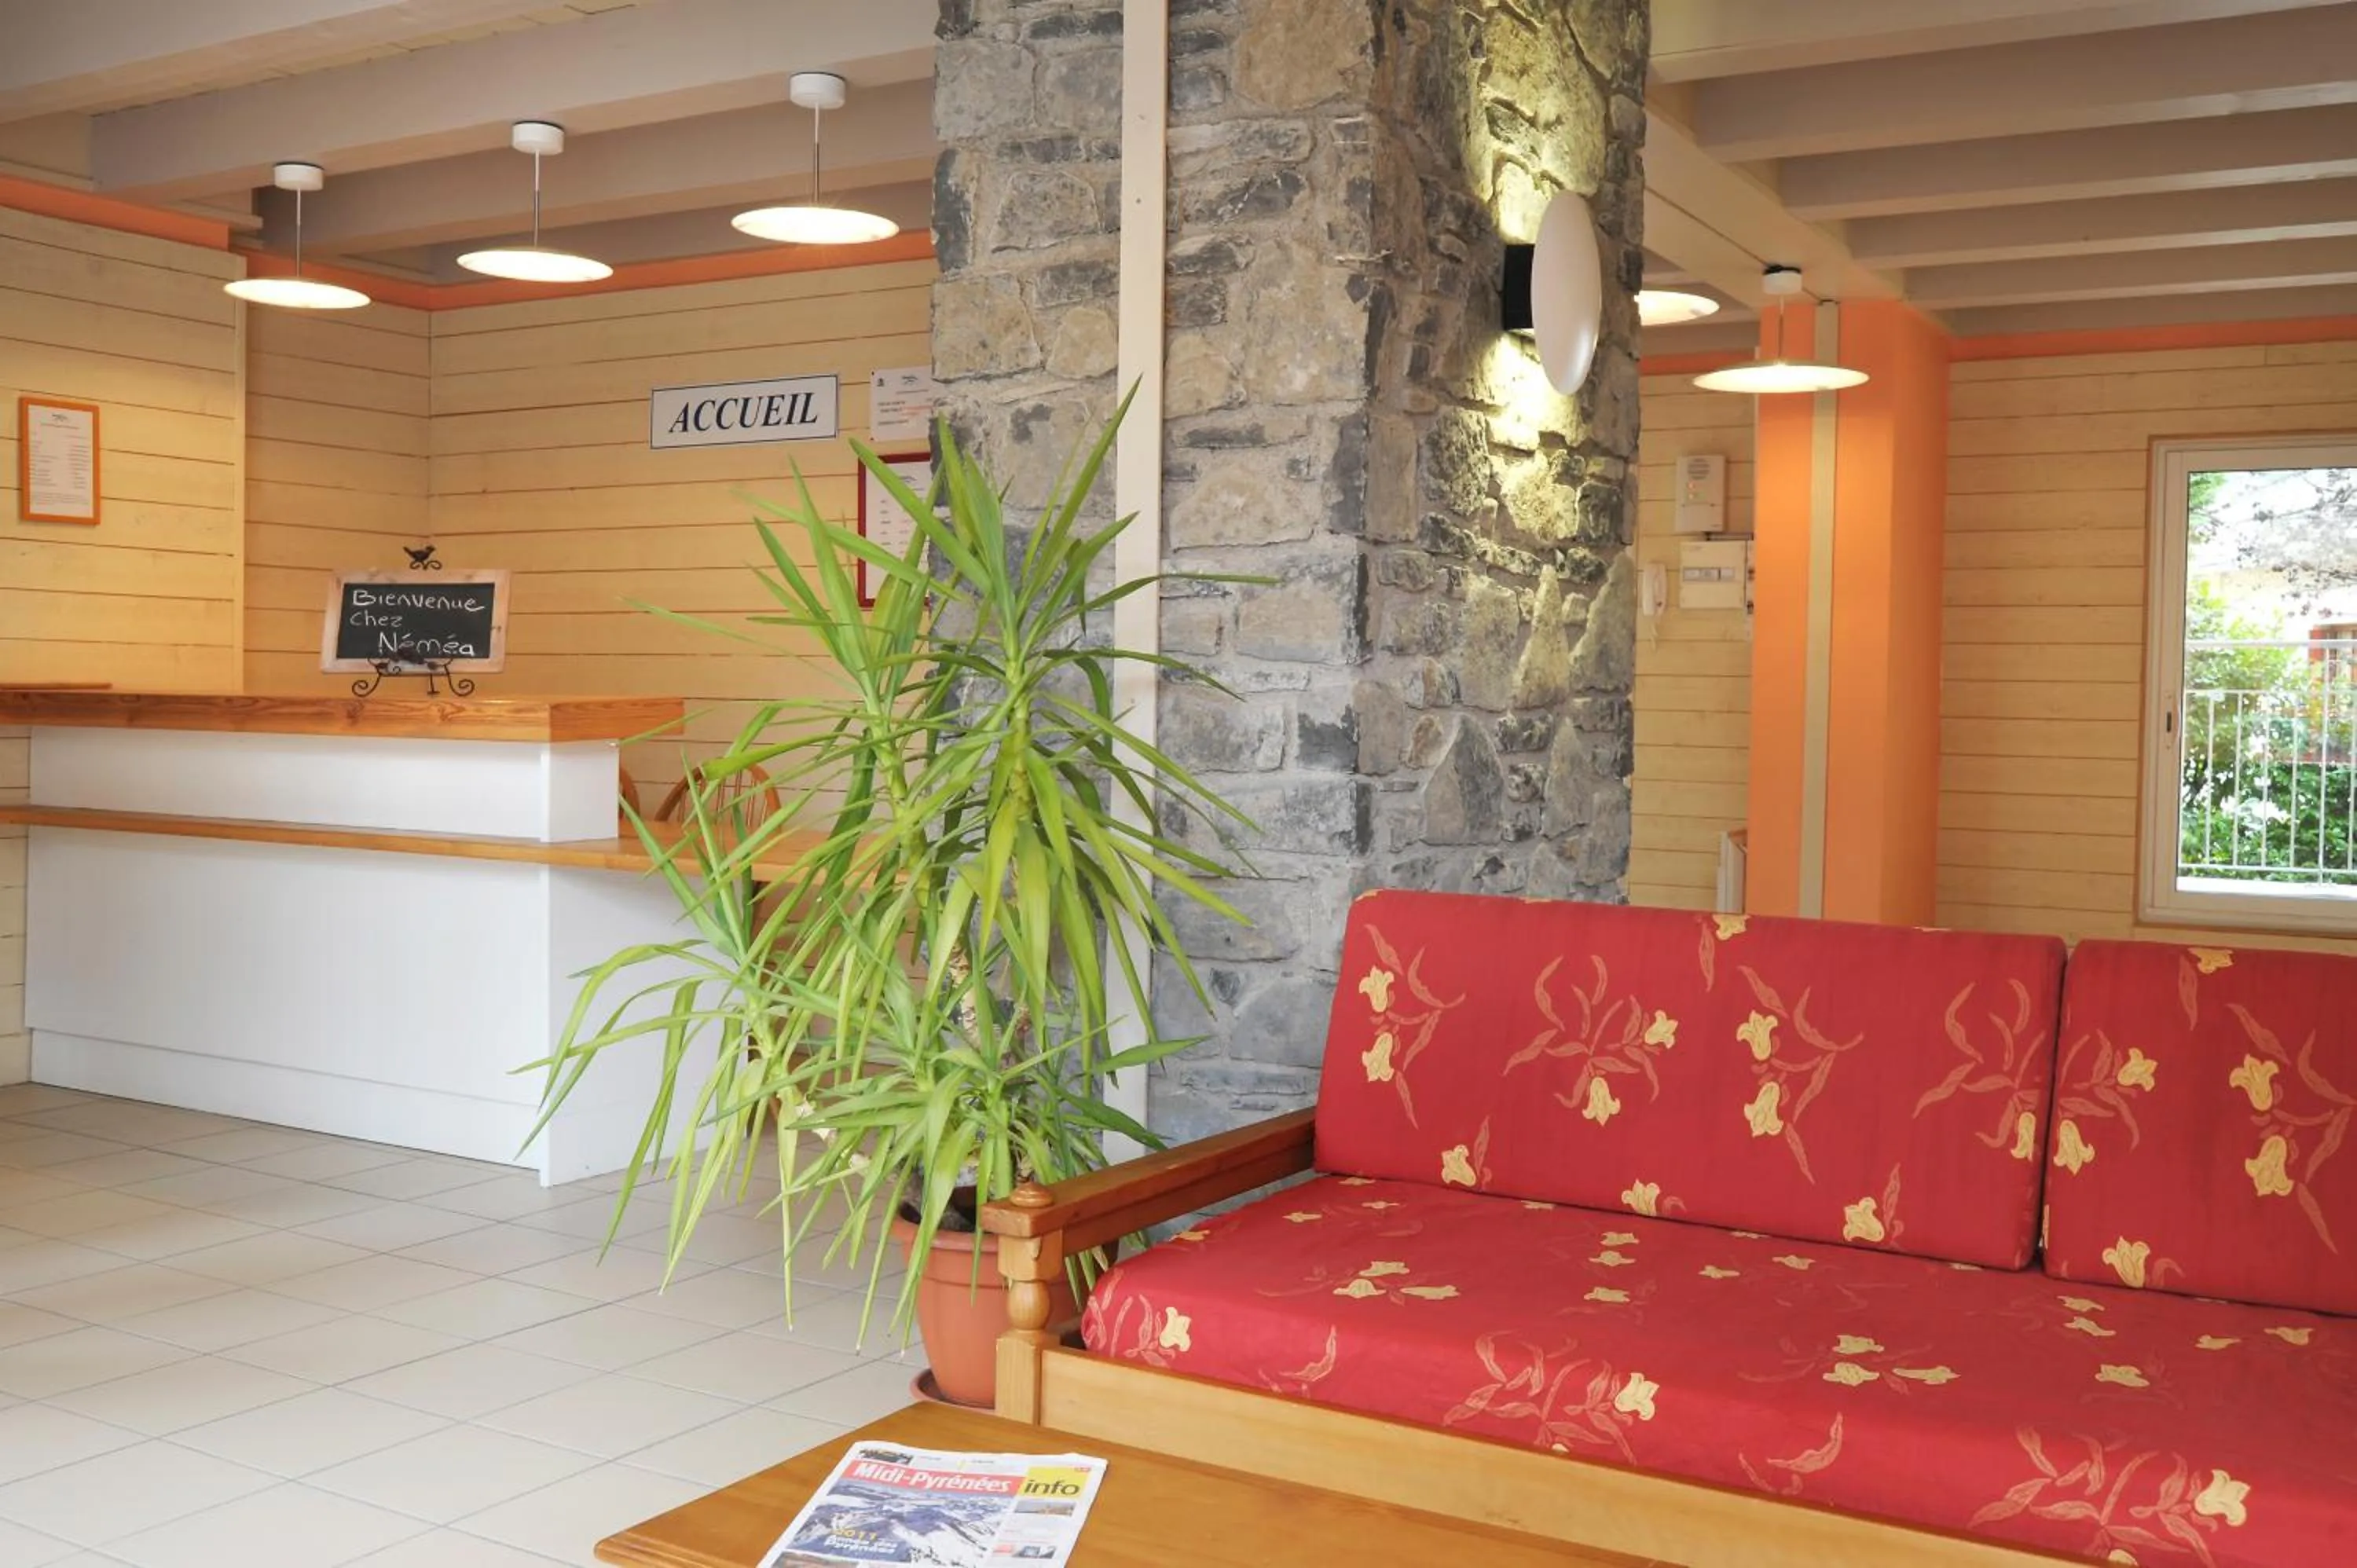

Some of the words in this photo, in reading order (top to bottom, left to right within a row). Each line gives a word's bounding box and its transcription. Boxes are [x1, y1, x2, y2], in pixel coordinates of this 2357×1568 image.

[669, 392, 818, 433] ACCUEIL
[353, 590, 485, 611] Bienvenue
[378, 632, 475, 656] Néméa
[852, 1462, 1014, 1493] Midi-Pyrénées
[1024, 1479, 1080, 1496] info
